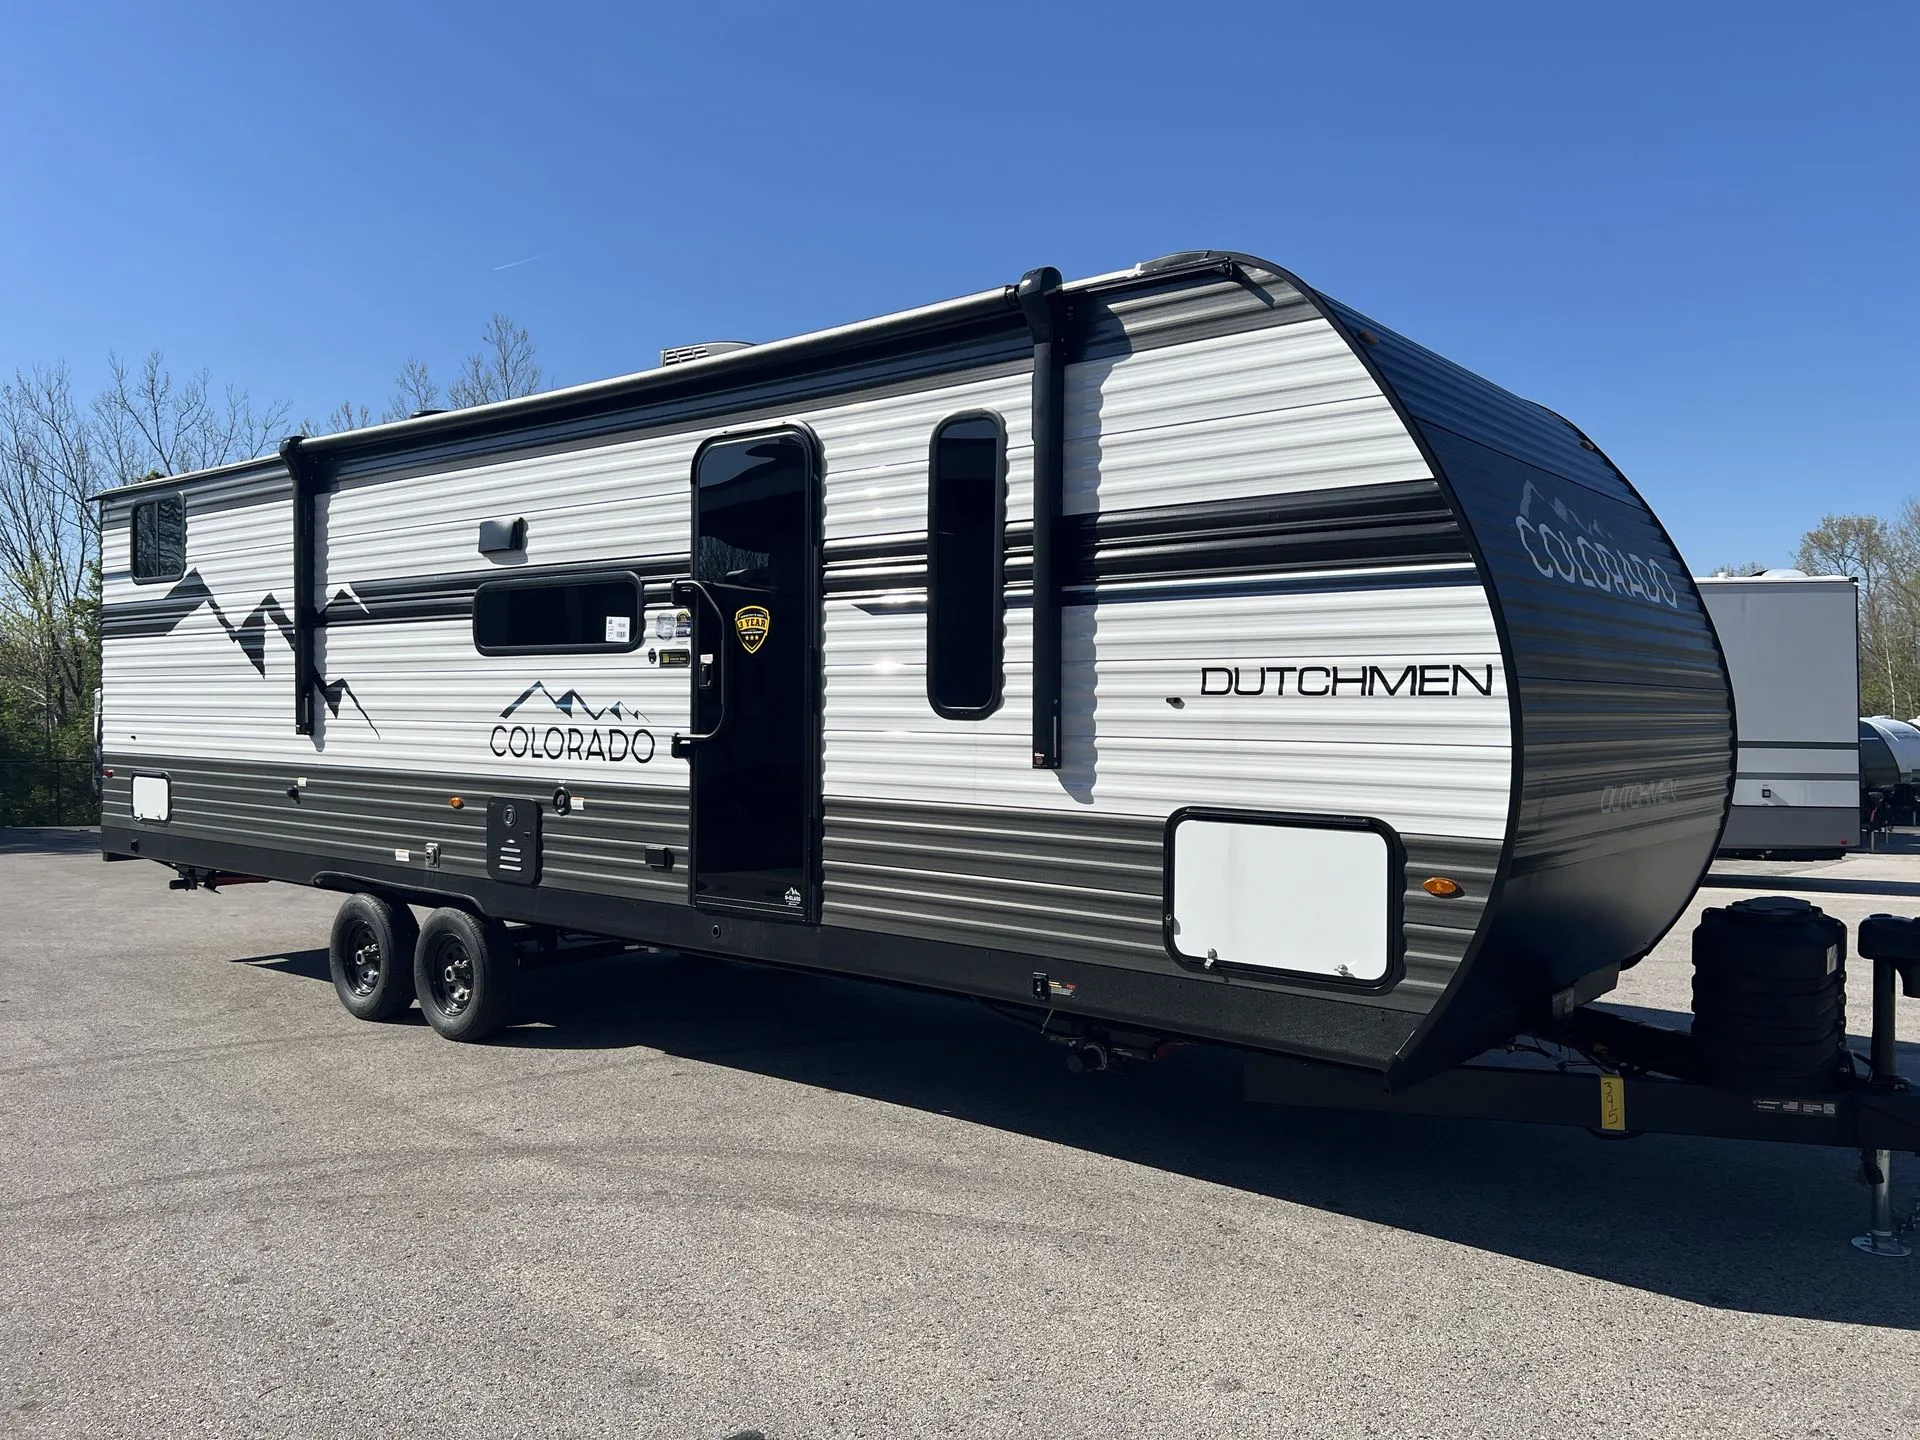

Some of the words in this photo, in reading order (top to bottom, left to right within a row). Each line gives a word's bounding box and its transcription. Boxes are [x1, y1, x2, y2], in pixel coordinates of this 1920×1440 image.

[1515, 515, 1679, 609] COLORADO
[738, 620, 744, 630] 3
[745, 618, 766, 628] YEAR
[1200, 663, 1493, 697] DUTCHMEN
[489, 725, 656, 764] COLORADO
[1603, 1081, 1619, 1125] 395
